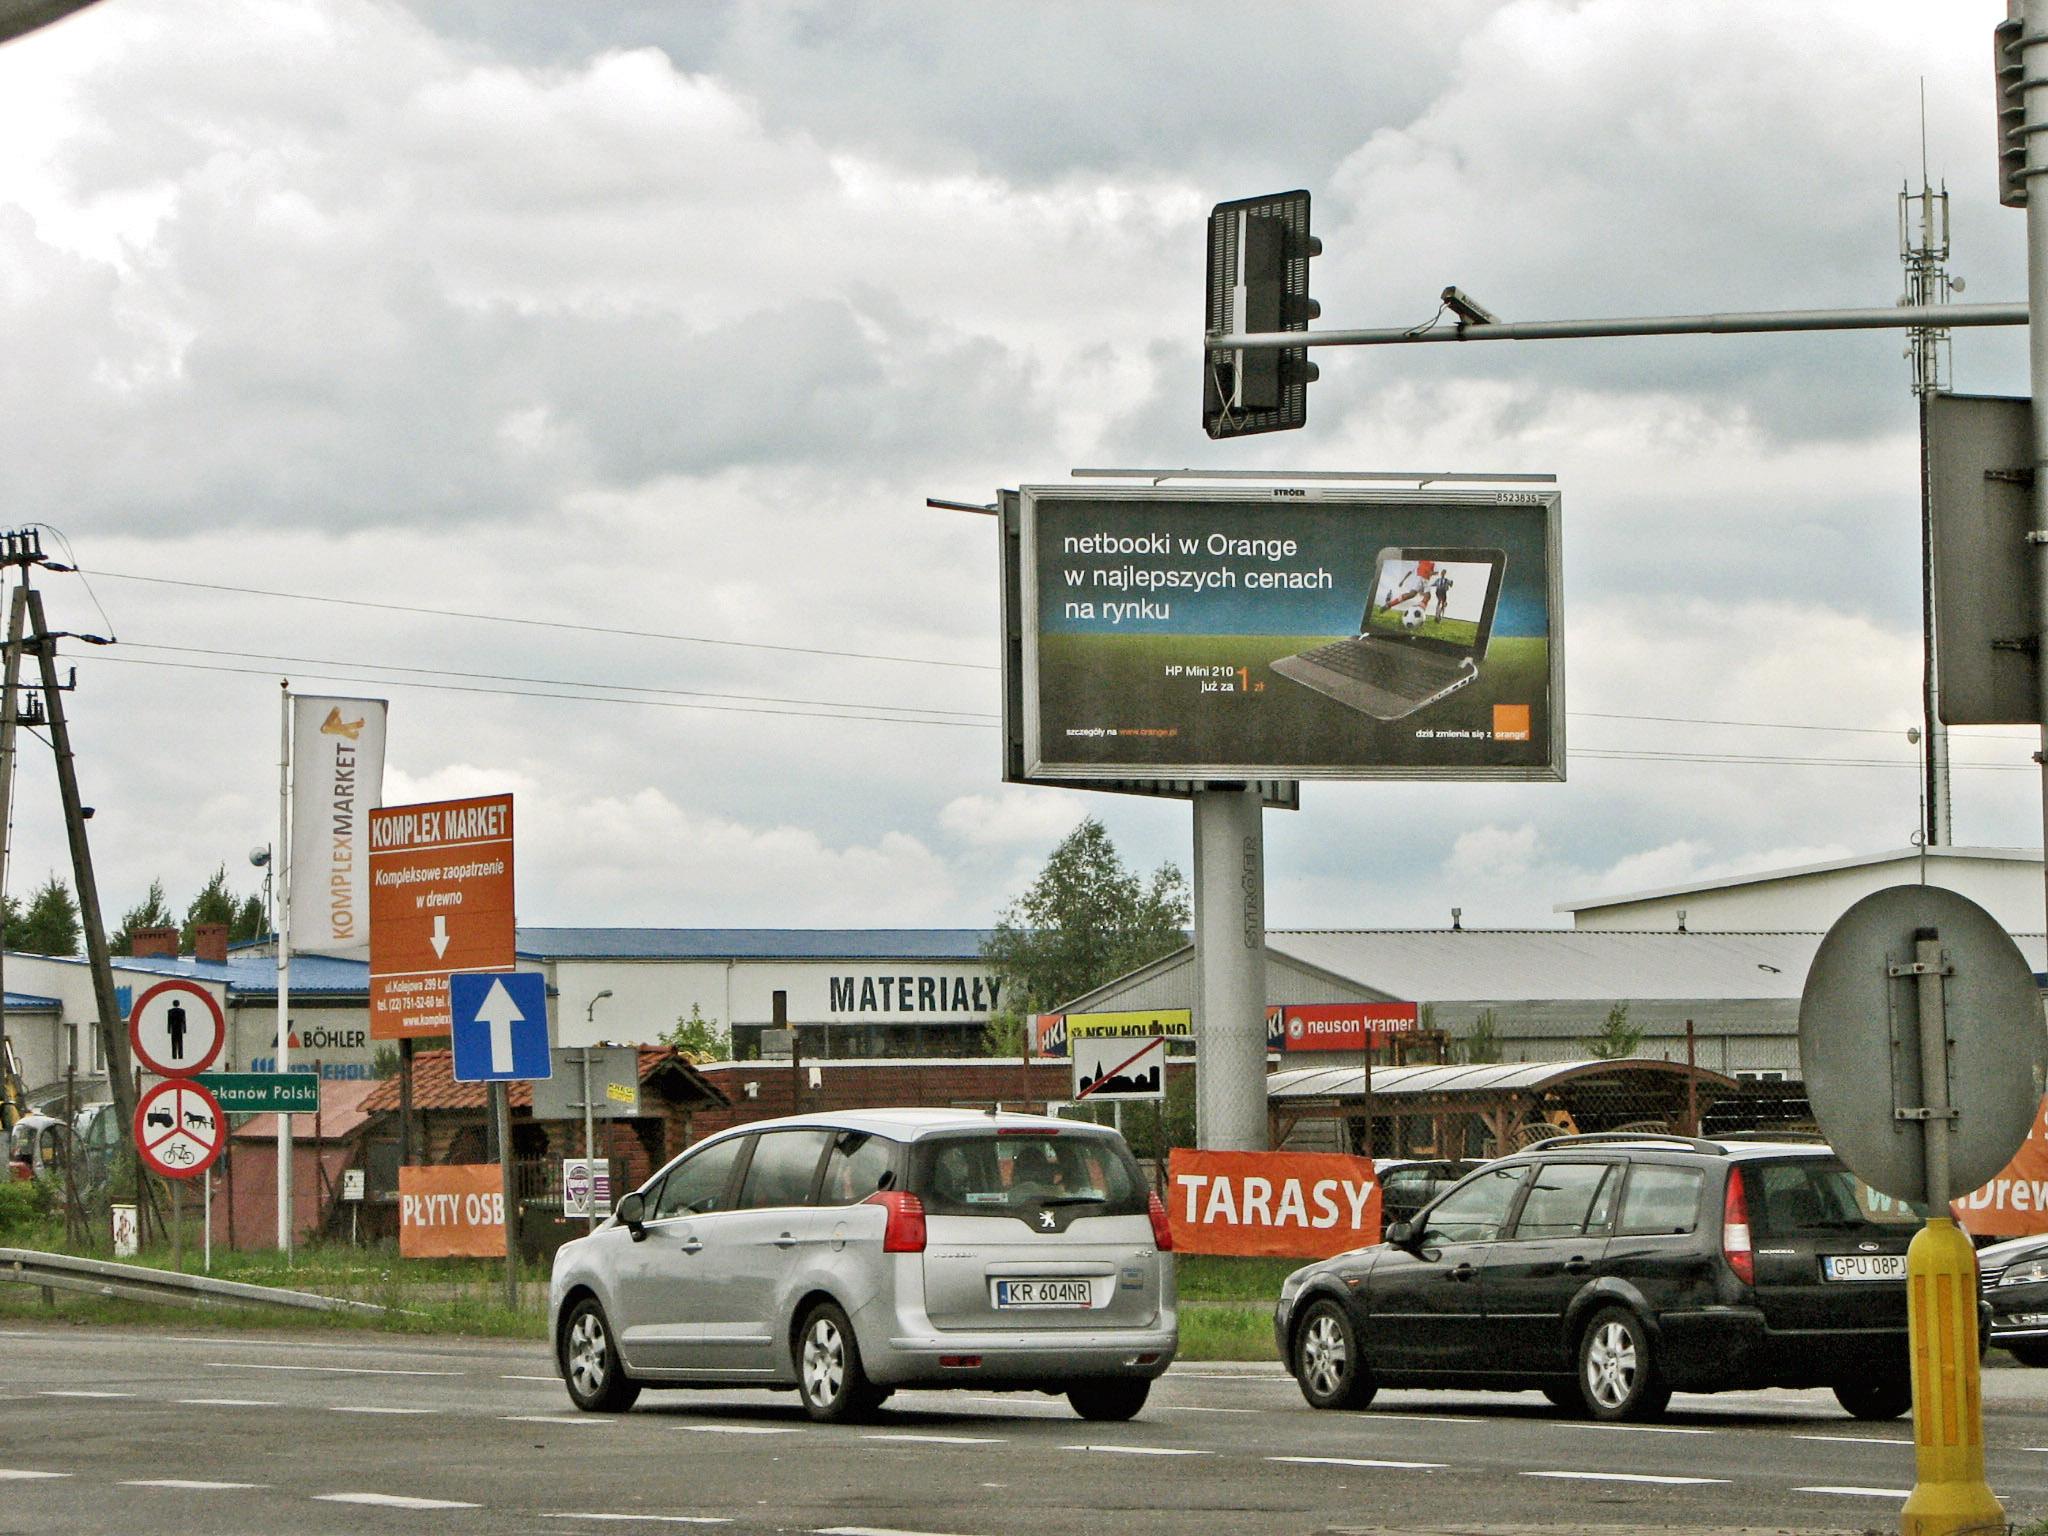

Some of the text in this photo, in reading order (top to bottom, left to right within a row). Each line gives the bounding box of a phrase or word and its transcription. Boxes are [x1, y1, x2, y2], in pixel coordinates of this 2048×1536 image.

[1496, 493, 1537, 503] 8523835
[1064, 533, 1297, 561] netbooki w Orange
[1064, 566, 1333, 592] w najlepszych cenach
[1065, 598, 1170, 624] na rynku
[1165, 665, 1234, 677] HP Mini 210
[1236, 665, 1249, 692] 1
[1201, 680, 1234, 693] już za
[372, 804, 508, 848] KOMPLEX MARKET
[375, 858, 505, 888] Kompleksowe zaopatrzenie
[416, 888, 463, 908] w drewno
[830, 976, 1003, 1012] MATERIAŁY
[303, 1026, 366, 1048] BÖHLER
[1041, 1015, 1066, 1049] HKL
[1307, 1015, 1415, 1034] neuson kramer
[206, 1085, 317, 1100] ekanów Polski
[402, 1192, 505, 1226] PŁYTY OSB
[1177, 1174, 1375, 1230] TARASY
[1835, 1257, 1867, 1275] GPU
[1009, 1283, 1087, 1301] KR 604NR
